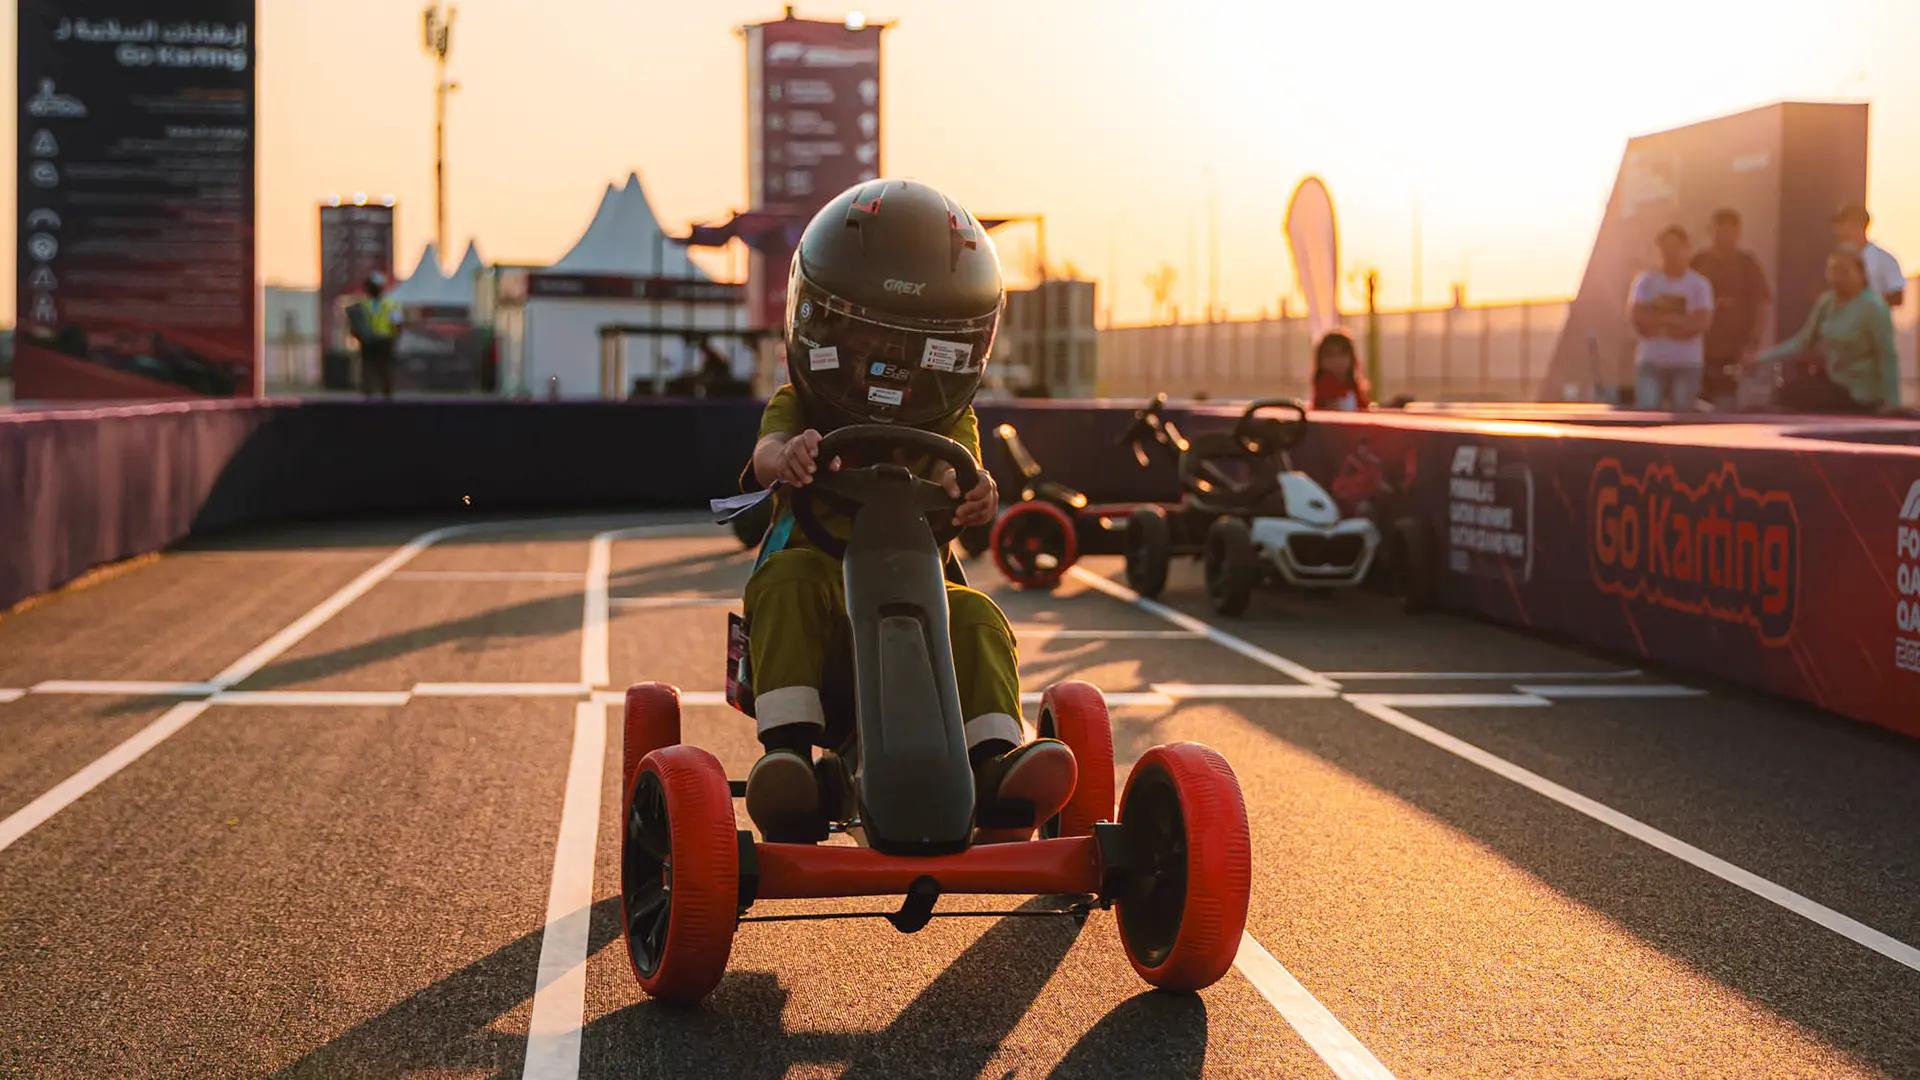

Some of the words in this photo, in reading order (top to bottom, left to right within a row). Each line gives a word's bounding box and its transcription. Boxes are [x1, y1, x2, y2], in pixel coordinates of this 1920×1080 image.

[117, 45, 154, 66] Go
[157, 46, 247, 72] Karting
[883, 278, 928, 296] GREX
[1595, 485, 1640, 570] Go
[1648, 494, 1789, 616] Karting
